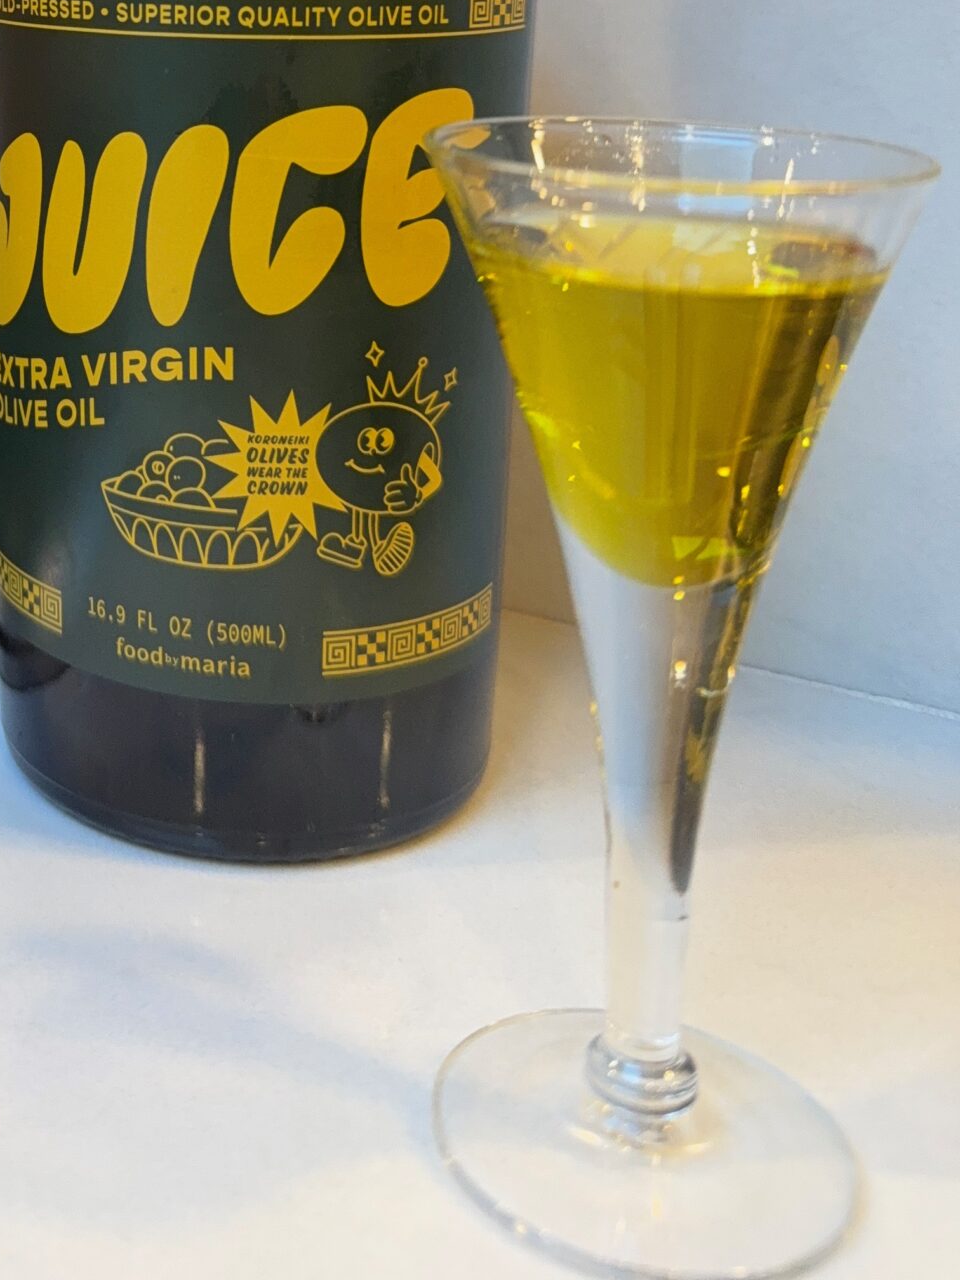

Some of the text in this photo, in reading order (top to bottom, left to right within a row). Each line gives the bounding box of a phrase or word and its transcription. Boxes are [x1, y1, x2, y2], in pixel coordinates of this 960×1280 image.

[116, 2, 230, 26] SUPERIOR
[237, 5, 341, 29] QUALITY
[348, 4, 412, 27] OLIVE
[418, 4, 449, 25] OIL
[81, 347, 235, 387] VIRGIN
[56, 397, 105, 428] OIL
[246, 434, 310, 446] KORONEIKI
[246, 447, 310, 465] OLIVES
[246, 467, 309, 479] WEAR THE
[246, 480, 308, 496] CROWN
[88, 596, 287, 649] 16.9 FL OZ (500ML)
